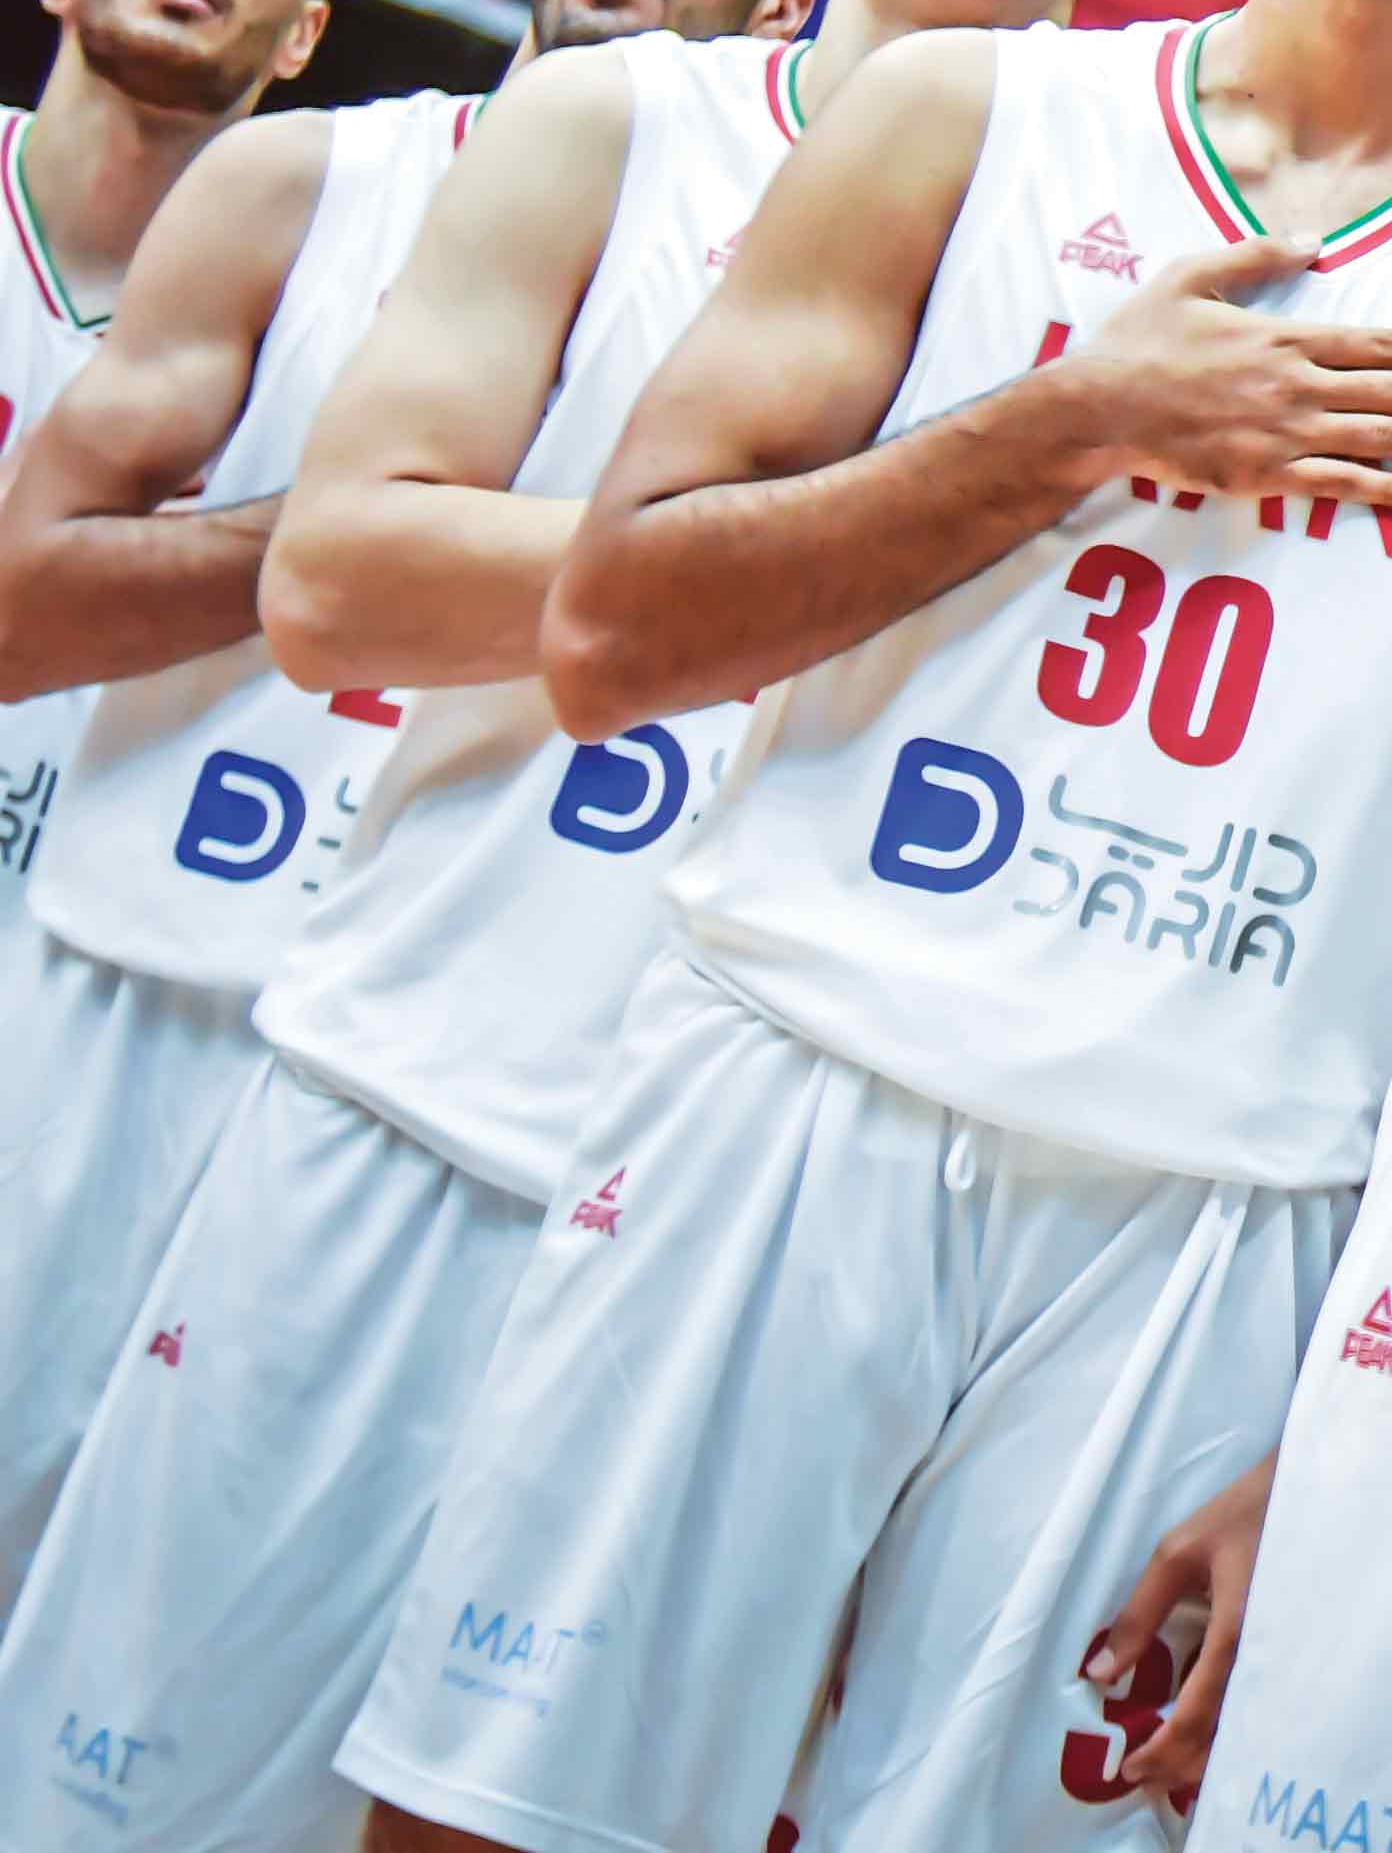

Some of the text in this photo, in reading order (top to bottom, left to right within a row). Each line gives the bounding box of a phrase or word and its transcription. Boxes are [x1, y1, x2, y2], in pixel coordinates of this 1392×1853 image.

[1059, 240, 1144, 285] PEAK
[1037, 544, 1275, 768] 30
[1012, 845, 1297, 987] DARIA
